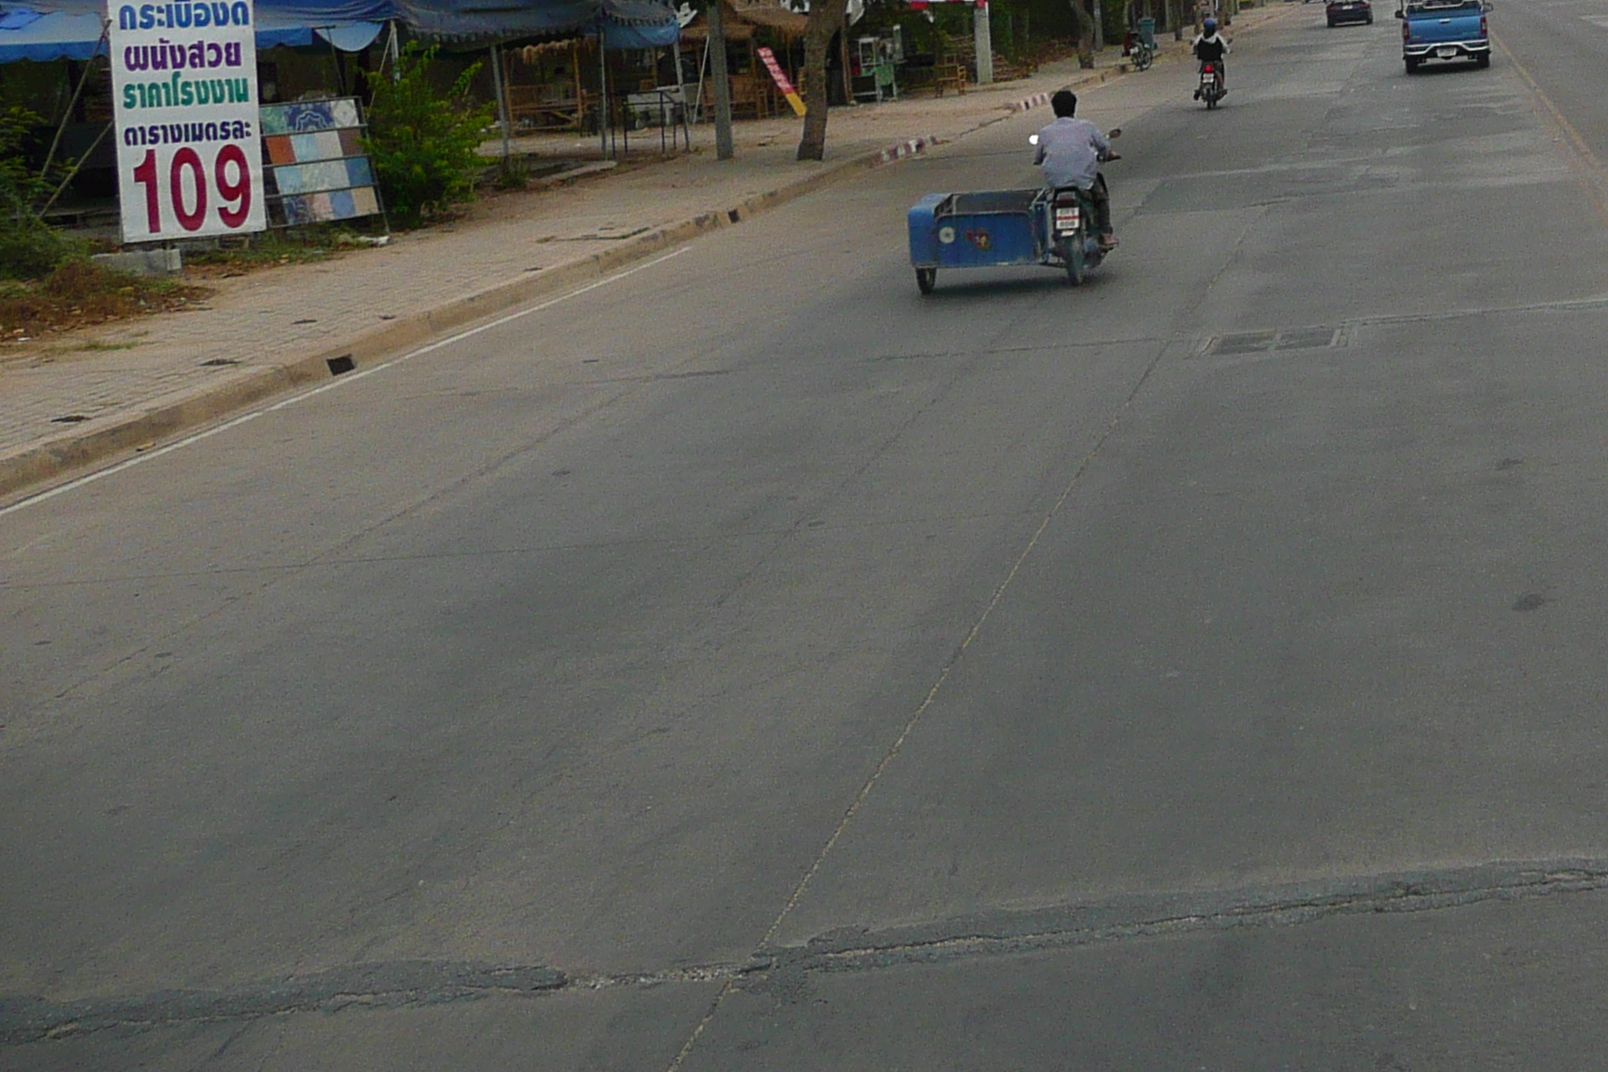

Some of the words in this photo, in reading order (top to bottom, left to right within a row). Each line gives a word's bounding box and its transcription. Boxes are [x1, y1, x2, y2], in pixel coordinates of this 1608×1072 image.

[124, 38, 242, 72] ผนังสวย
[123, 71, 249, 109] ราคาโรงงาน
[124, 120, 252, 147] ตารางเมตรละ
[133, 144, 252, 234] 109
